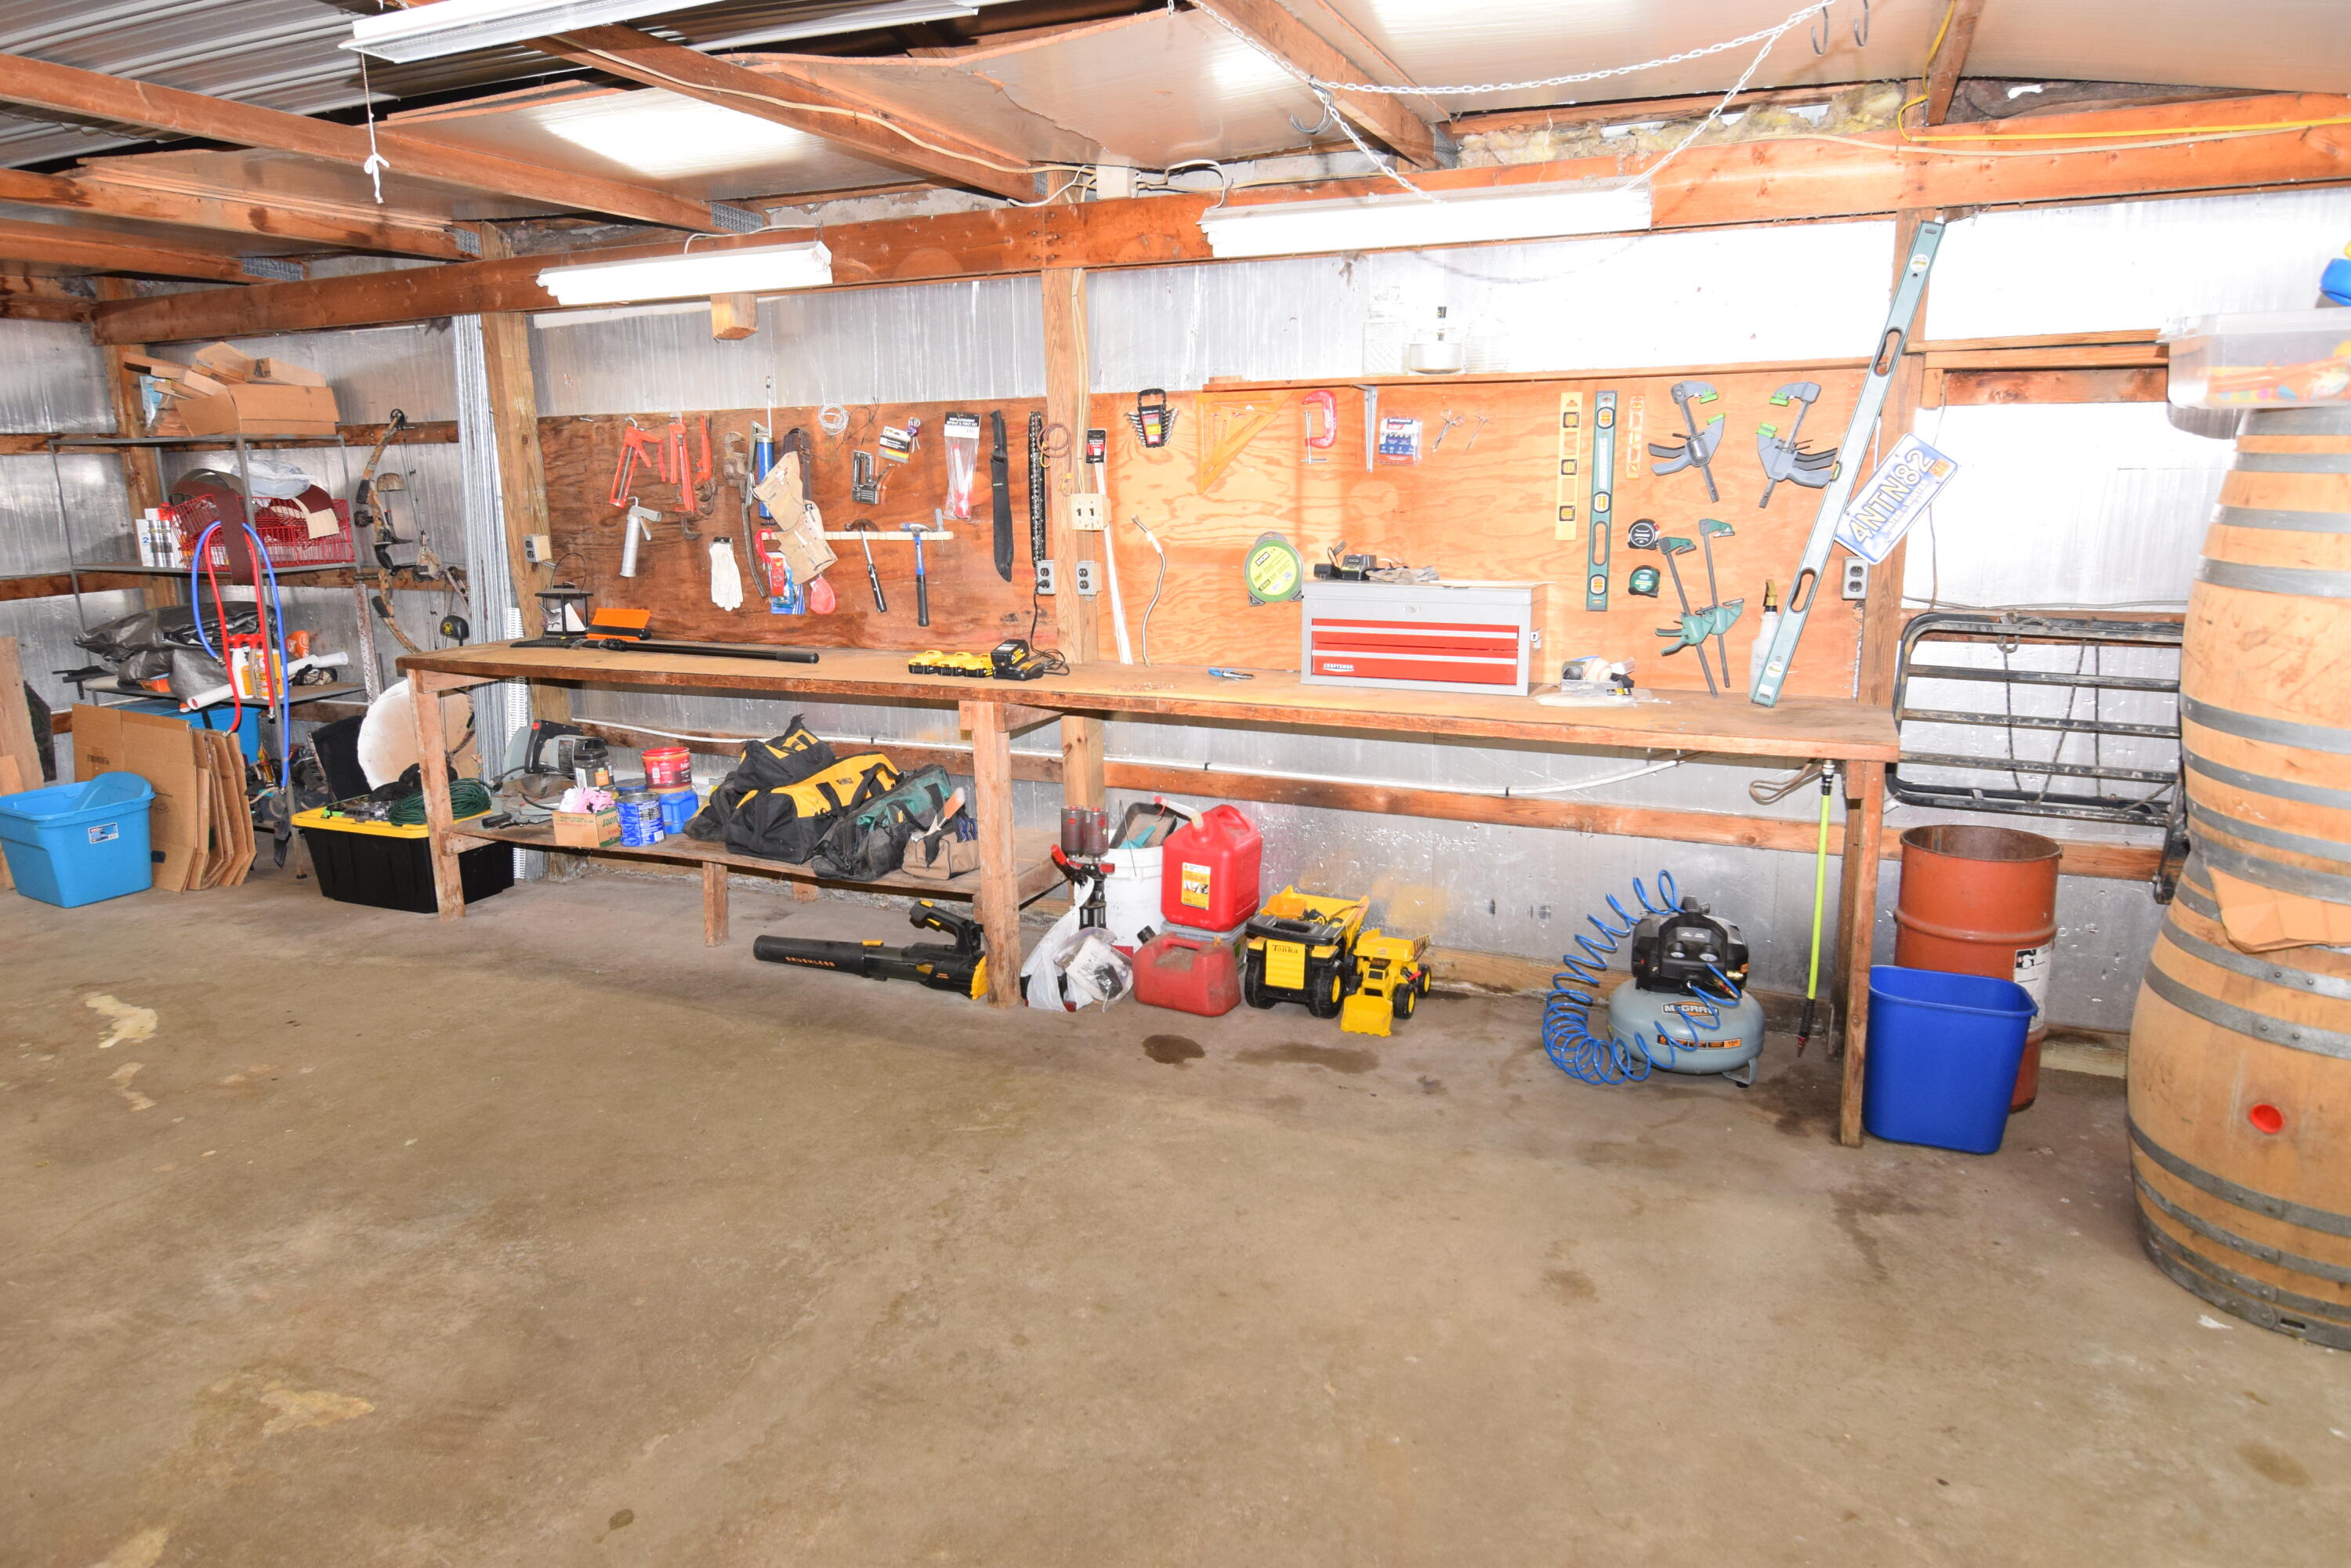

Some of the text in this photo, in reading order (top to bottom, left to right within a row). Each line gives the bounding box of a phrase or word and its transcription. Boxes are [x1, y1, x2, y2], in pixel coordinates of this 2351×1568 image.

[1849, 449, 1936, 544] 4NTN82
[1272, 945, 1299, 954] Tonka
[784, 956, 836, 967] BRUSHLESS
